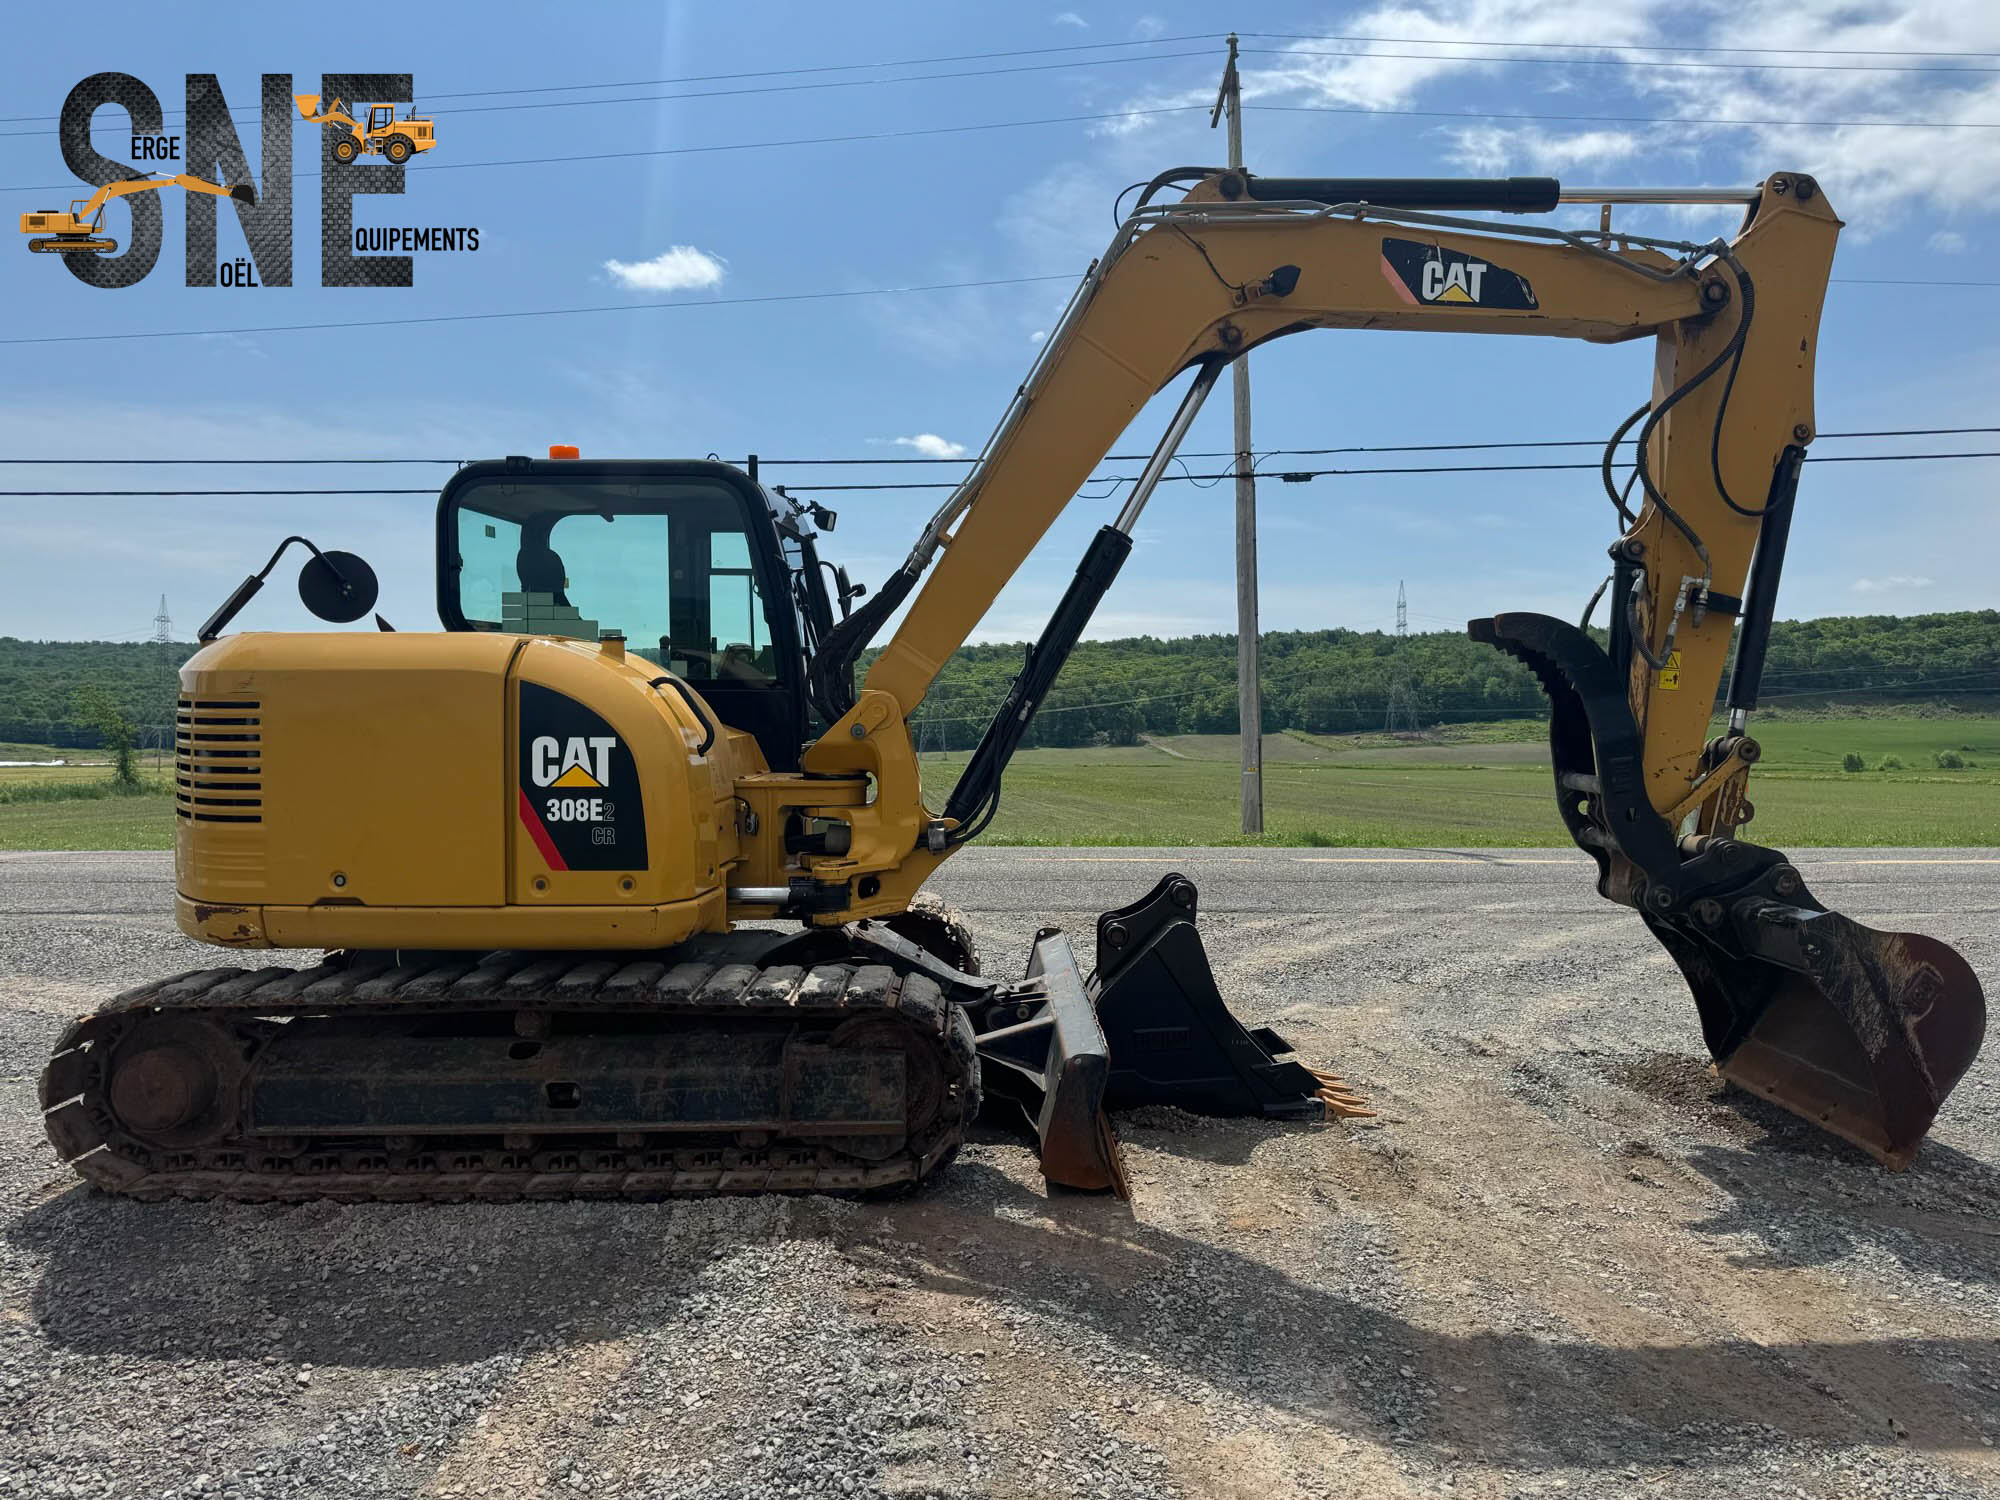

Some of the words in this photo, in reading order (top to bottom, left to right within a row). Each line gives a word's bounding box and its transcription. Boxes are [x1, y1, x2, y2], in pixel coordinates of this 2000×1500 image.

[1422, 261, 1487, 302] CAT
[532, 736, 616, 787] CAT
[592, 827, 615, 844] CR
